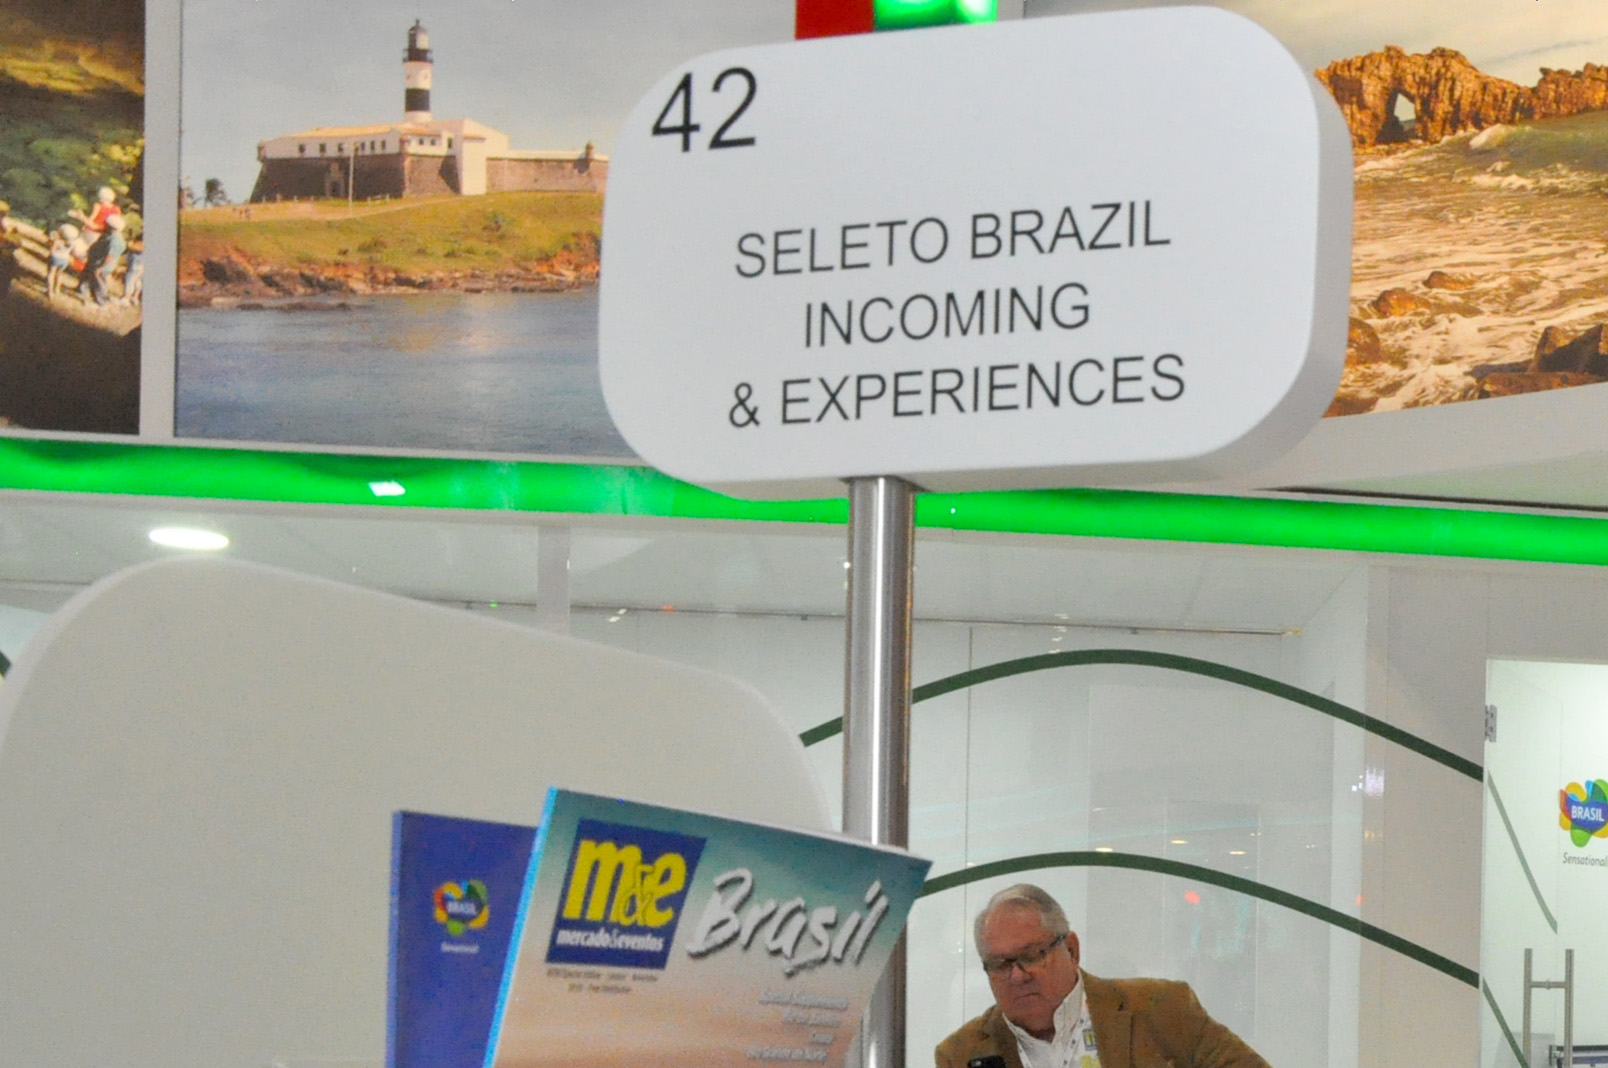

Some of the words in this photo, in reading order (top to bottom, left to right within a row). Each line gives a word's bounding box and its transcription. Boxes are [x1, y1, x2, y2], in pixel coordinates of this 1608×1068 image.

[650, 66, 758, 154] 42
[735, 217, 949, 279] SELETO
[970, 200, 1172, 261] BRAZIL
[804, 282, 1091, 349] INCOMING
[728, 382, 761, 429] &
[781, 353, 1187, 426] EXPERIENCES
[1571, 804, 1605, 822] BRASIL
[687, 868, 889, 978] Brasil
